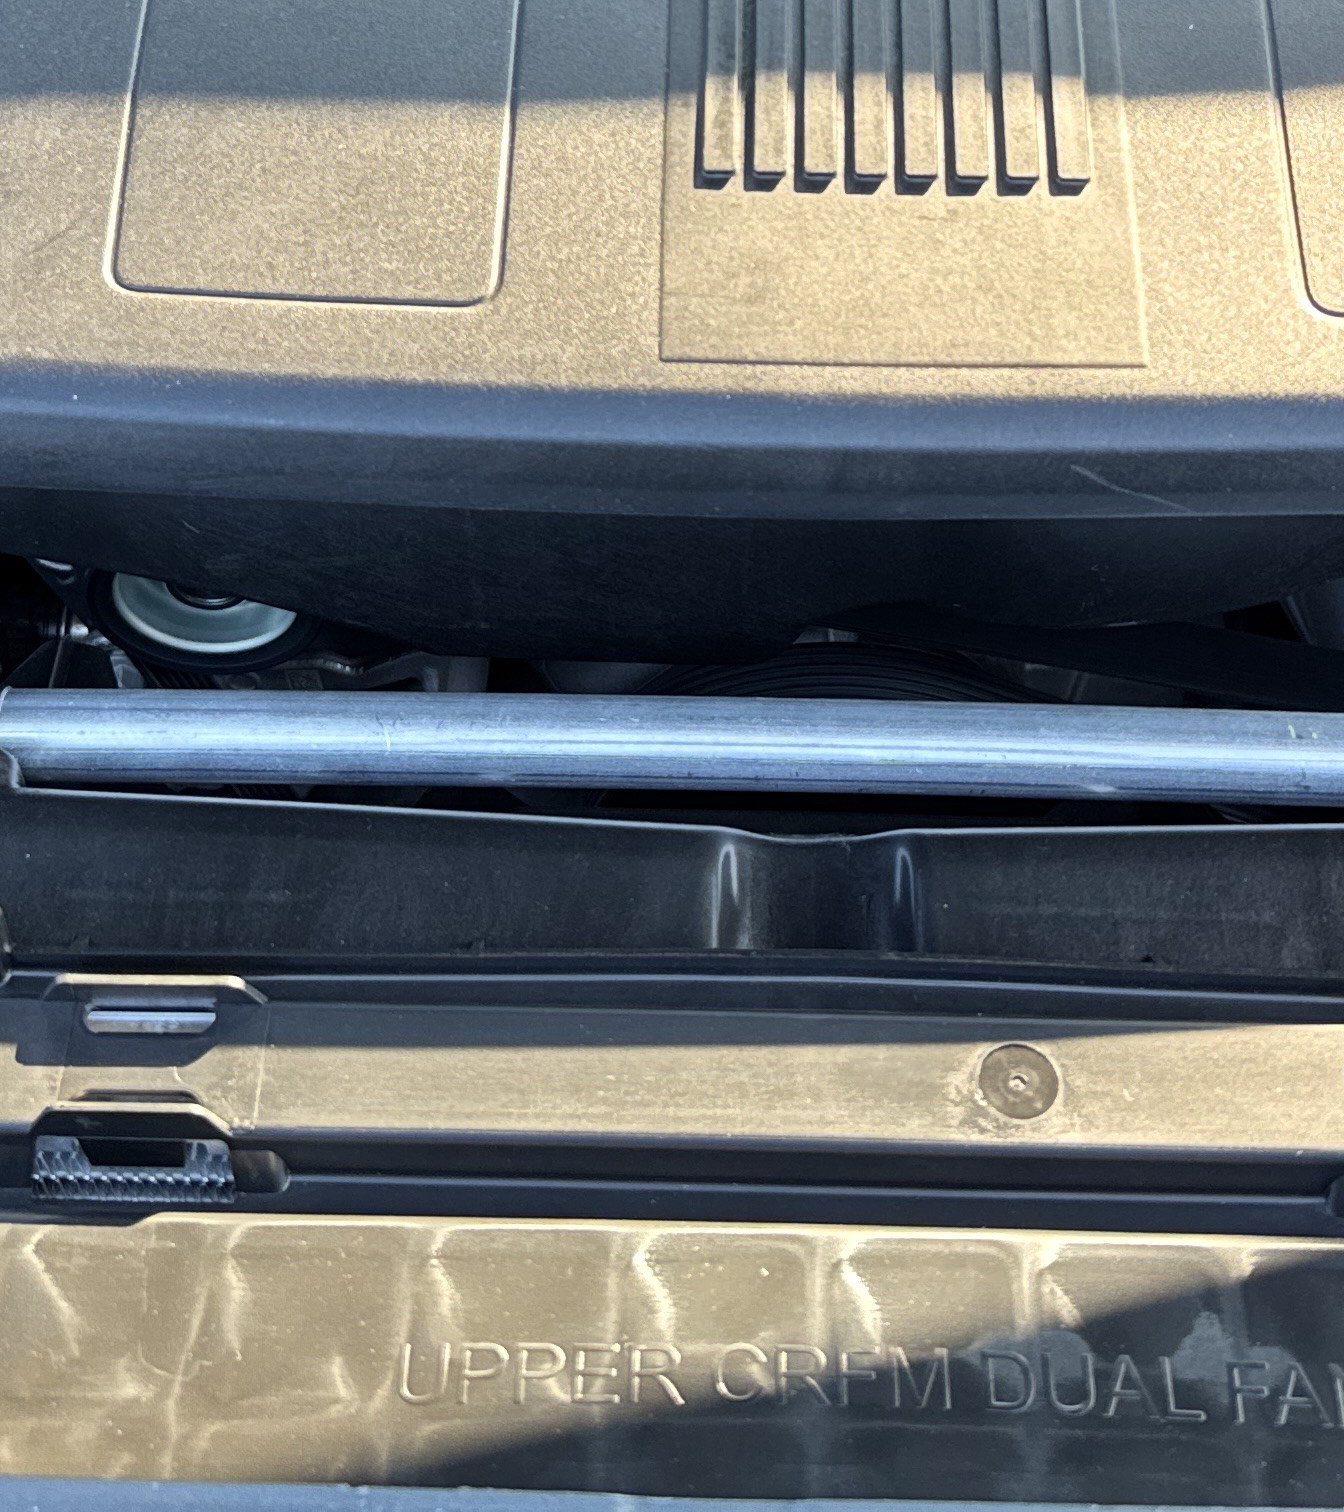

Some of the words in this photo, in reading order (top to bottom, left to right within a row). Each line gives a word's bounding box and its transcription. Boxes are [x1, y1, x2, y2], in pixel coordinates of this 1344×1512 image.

[397, 1340, 687, 1407] UPPER
[715, 1341, 953, 1410] CRFM
[980, 1348, 1208, 1423] DUAL
